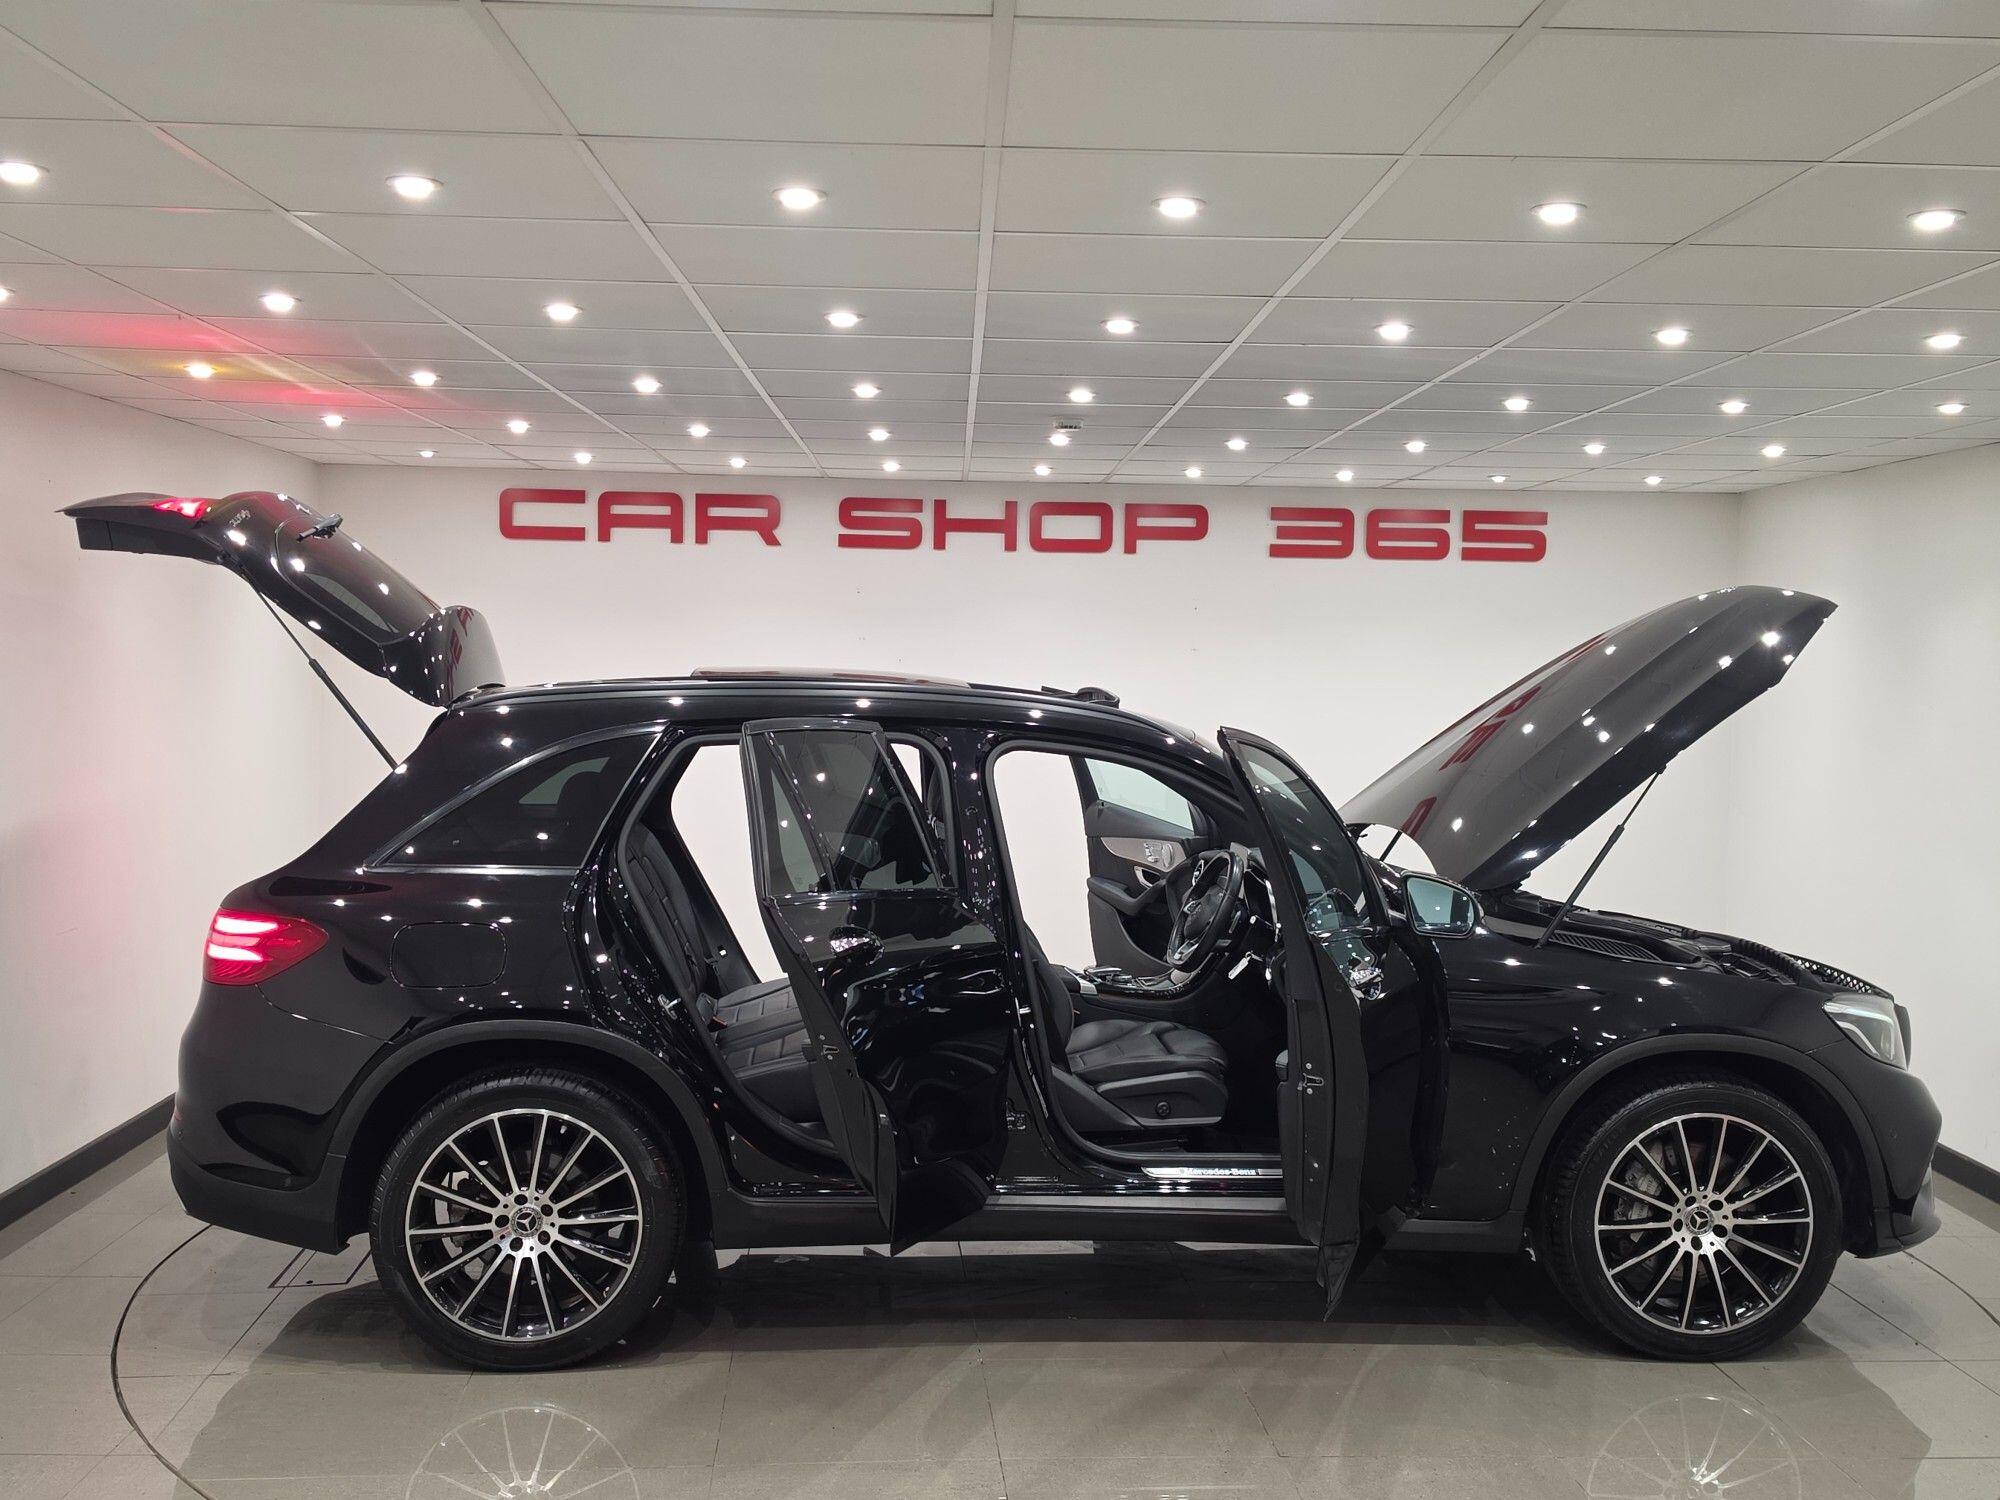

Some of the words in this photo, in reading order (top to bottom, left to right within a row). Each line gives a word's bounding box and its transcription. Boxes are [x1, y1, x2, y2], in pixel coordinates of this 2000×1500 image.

[499, 487, 780, 546] CAR
[836, 496, 1209, 554] SHOP
[1268, 507, 1548, 561] 365
